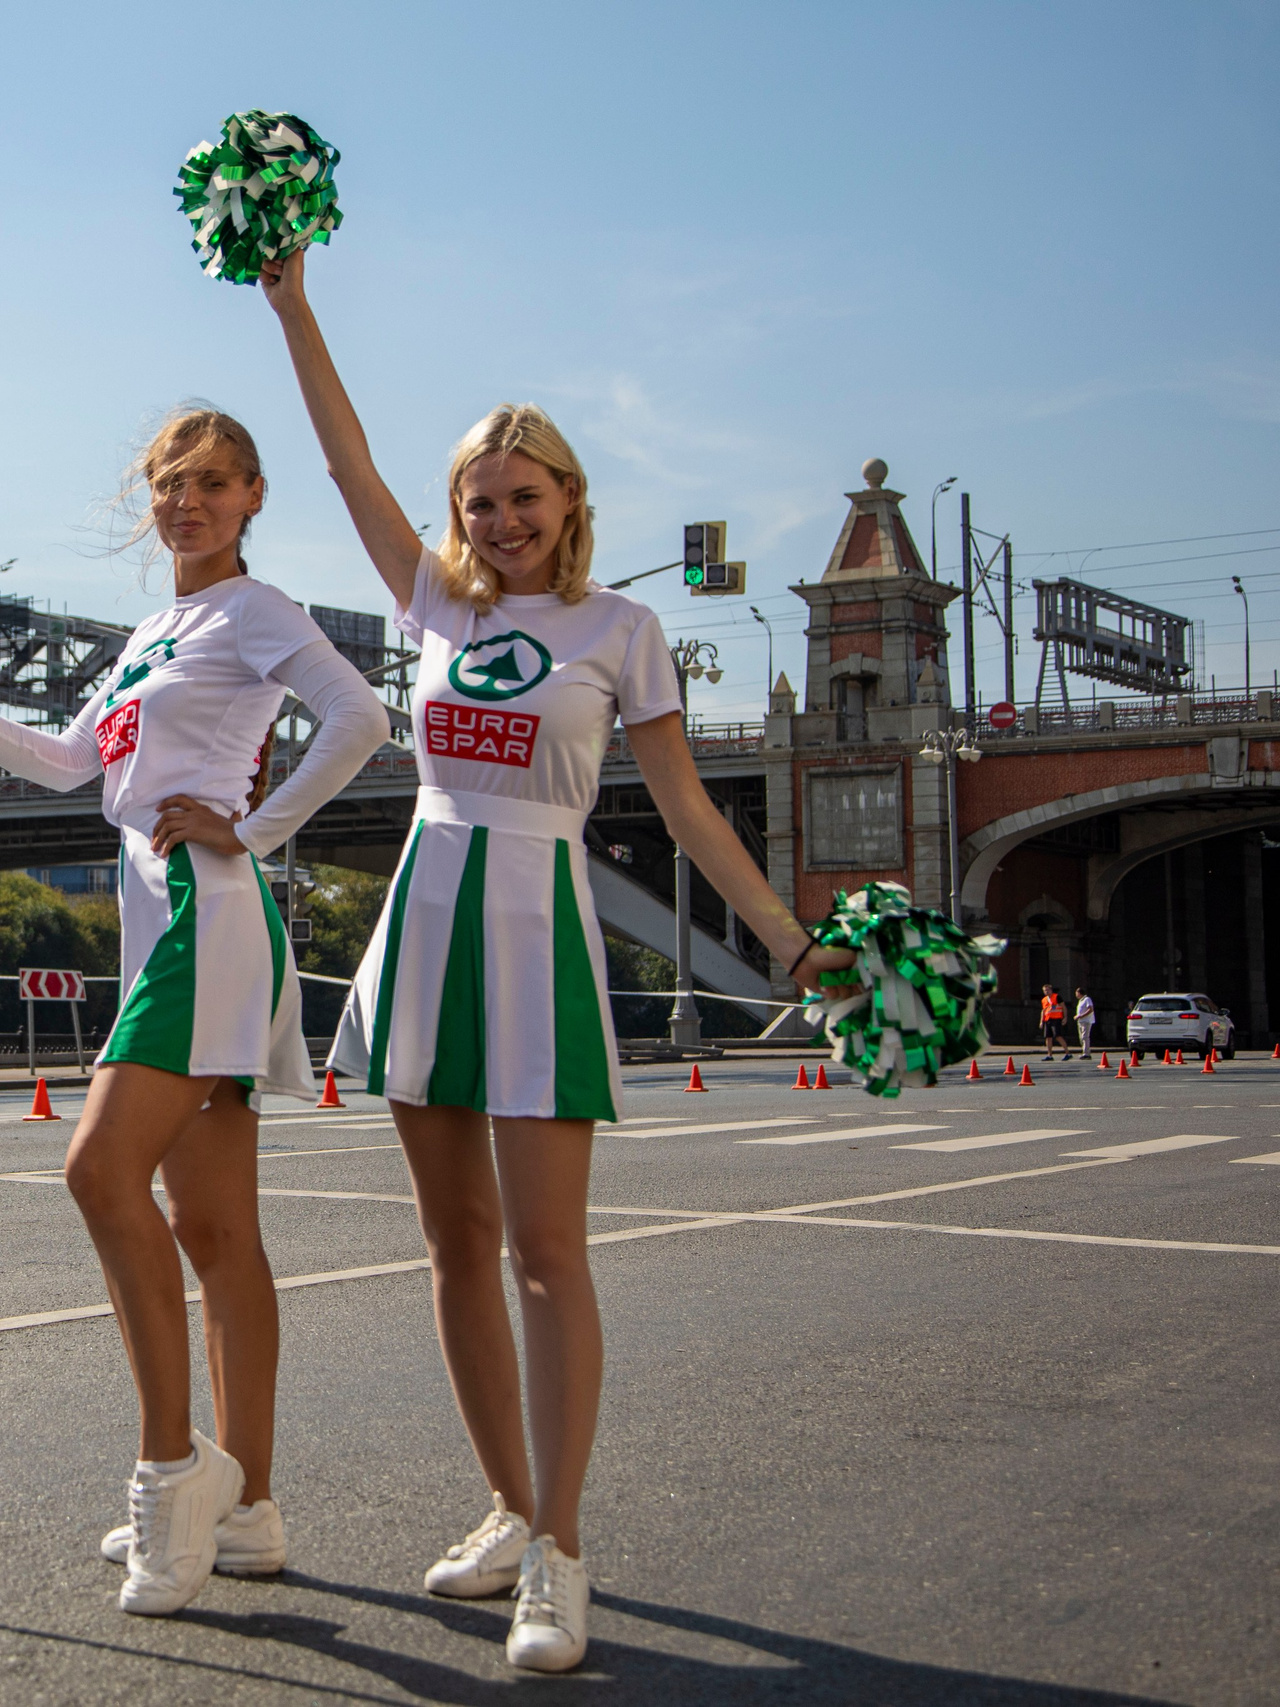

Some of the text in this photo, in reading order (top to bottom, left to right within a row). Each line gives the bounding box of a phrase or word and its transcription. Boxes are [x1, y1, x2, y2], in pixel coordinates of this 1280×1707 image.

[97, 704, 137, 748] EURO
[428, 706, 533, 738] EURO
[102, 727, 138, 763] SPAR
[430, 730, 528, 762] SPAR
